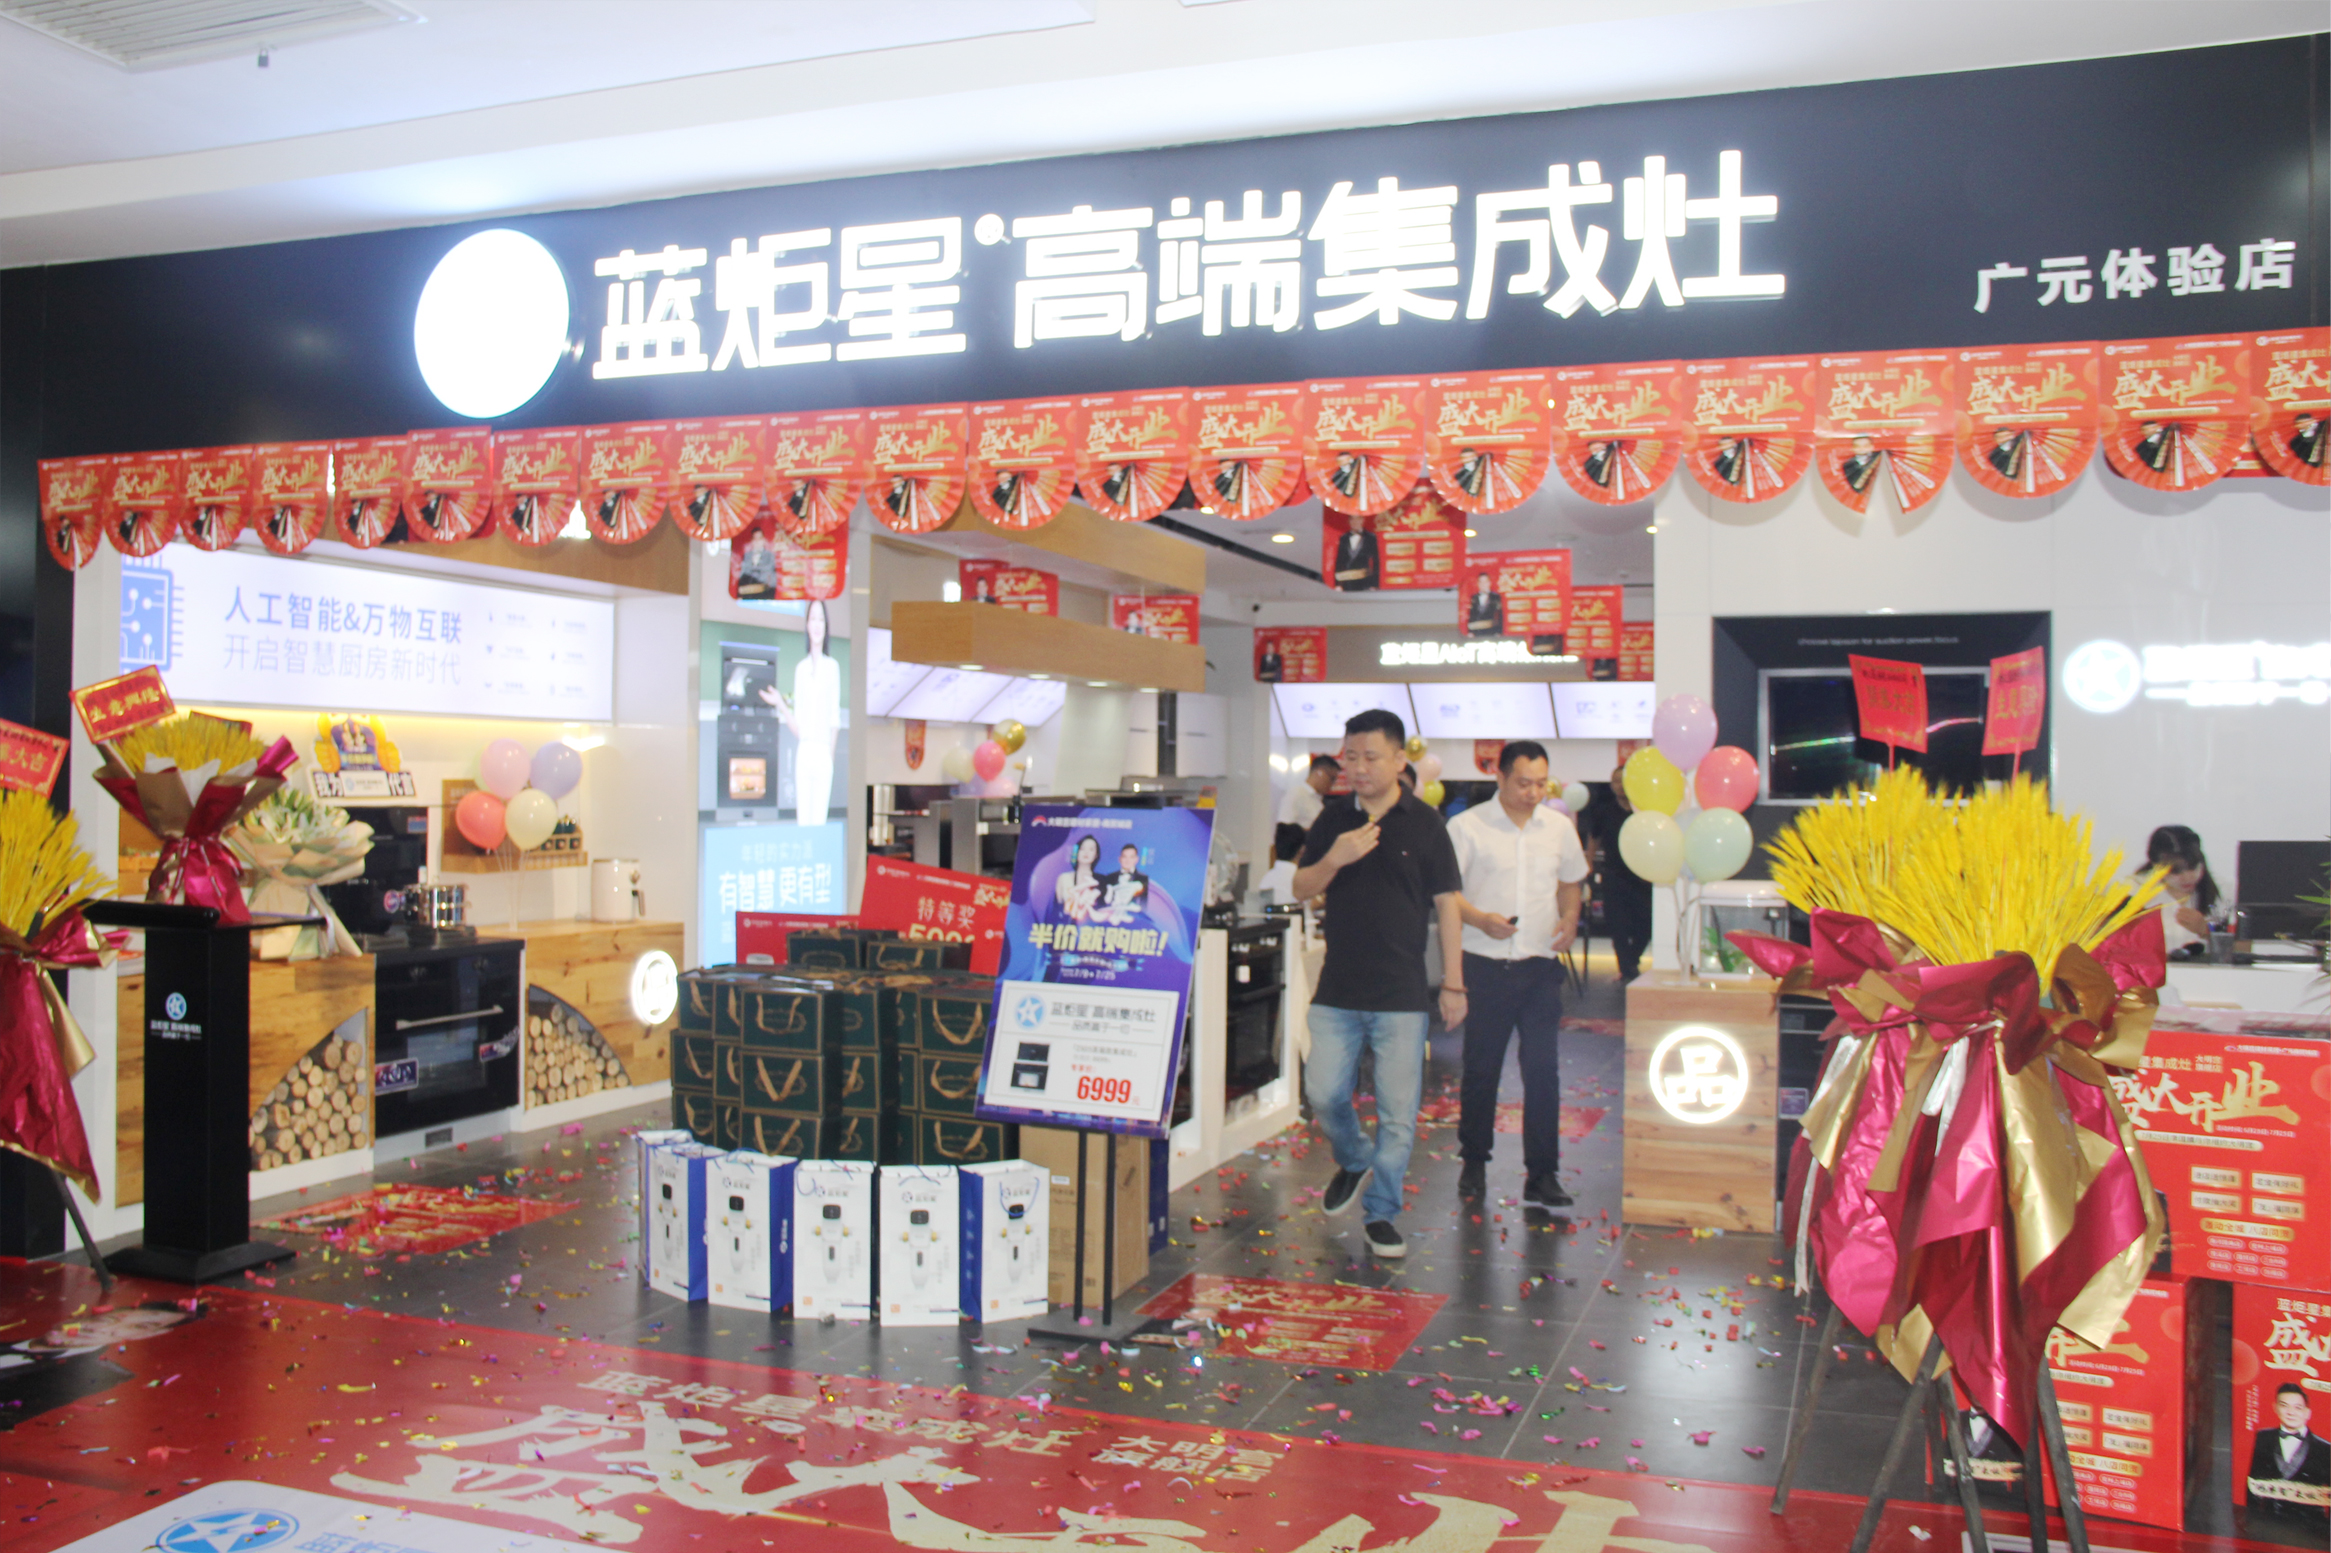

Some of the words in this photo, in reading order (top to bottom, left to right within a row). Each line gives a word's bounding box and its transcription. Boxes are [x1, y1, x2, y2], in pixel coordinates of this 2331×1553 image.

[592, 215, 967, 380] 蓝炬星
[1012, 150, 1786, 350] 高端集成灶
[1972, 237, 2297, 314] 广元体验店
[225, 586, 462, 644] 人工智能&万物互联
[223, 633, 462, 685] 开启智慧厨房新时代
[718, 867, 776, 914] 有智慧
[779, 862, 832, 907] 更有型
[917, 896, 976, 930] 特等奖
[1028, 922, 1169, 957] 半价就购啦!
[1077, 1075, 1133, 1105] 6999
[2263, 1311, 2331, 1378] 盛
